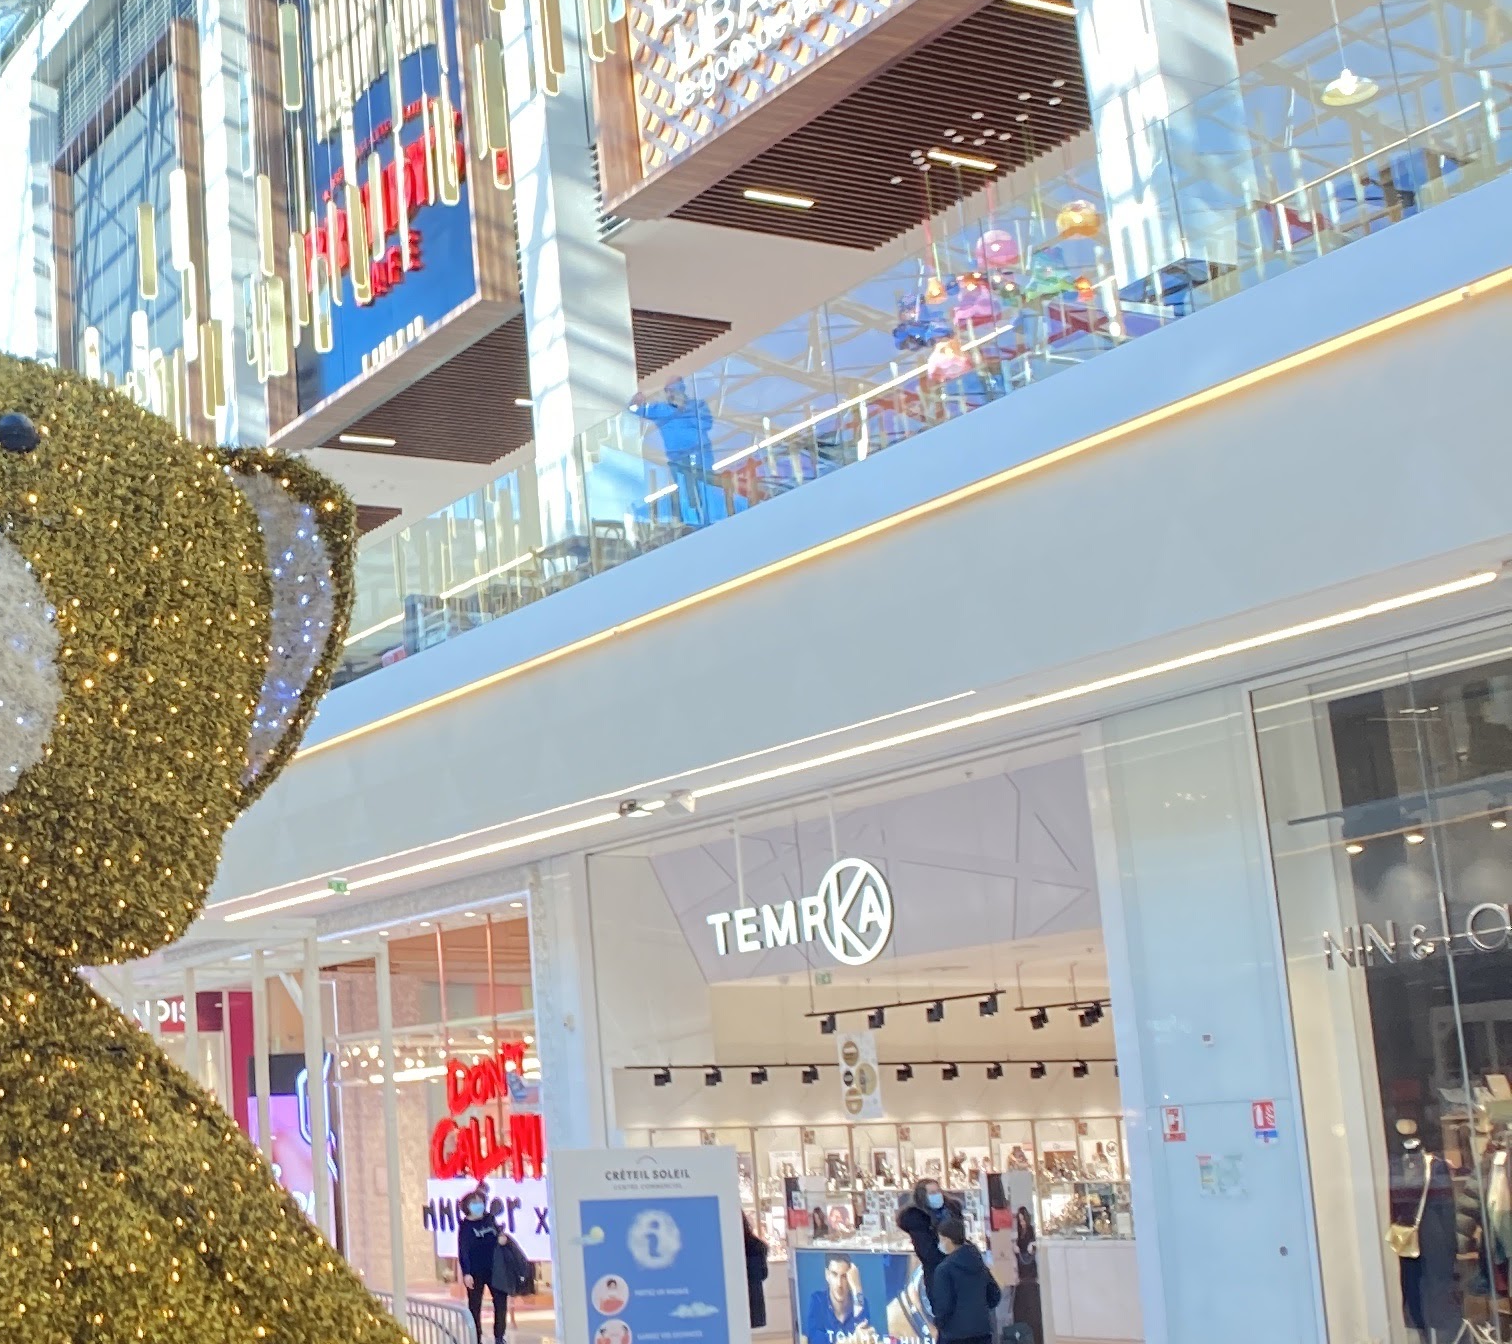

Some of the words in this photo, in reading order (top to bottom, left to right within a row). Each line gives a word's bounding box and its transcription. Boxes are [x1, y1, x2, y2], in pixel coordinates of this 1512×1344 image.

[431, 1115, 512, 1181] CALL
[605, 1168, 650, 1181] CRÉTEIL
[653, 1168, 691, 1179] SOLEIL
